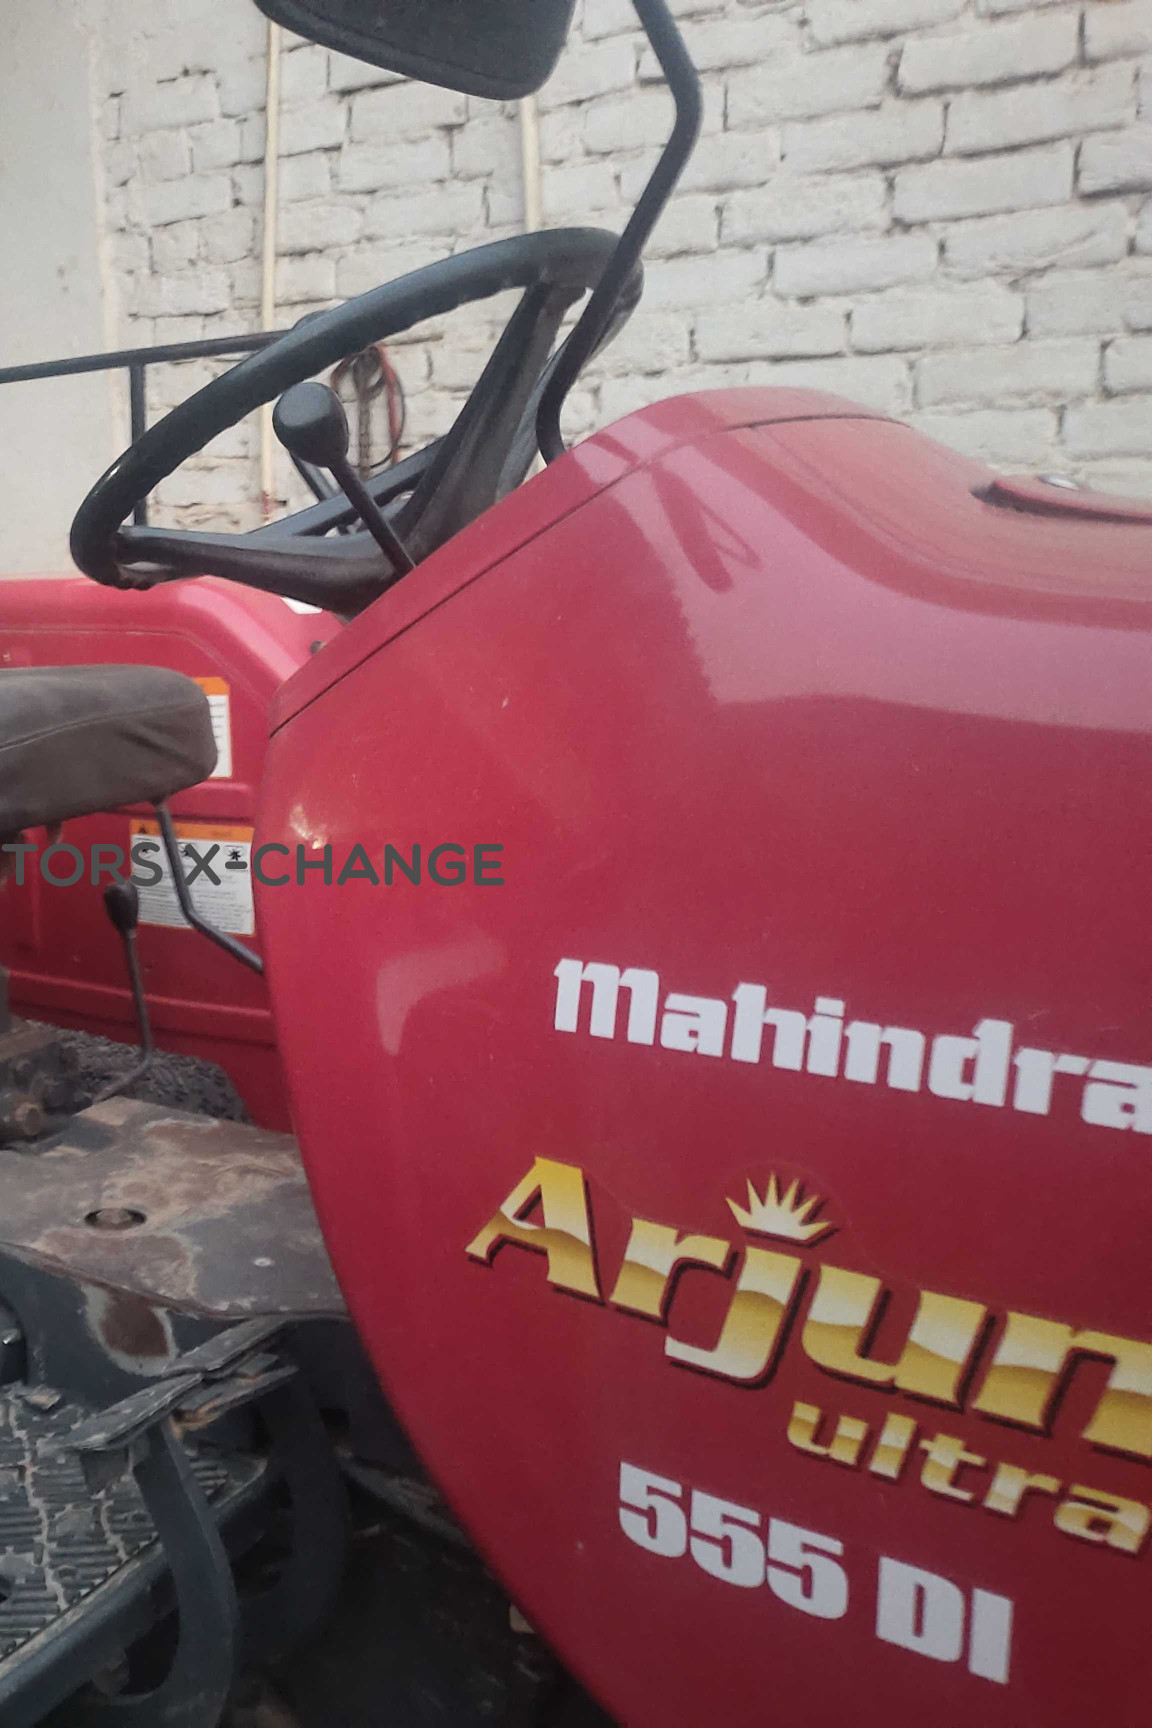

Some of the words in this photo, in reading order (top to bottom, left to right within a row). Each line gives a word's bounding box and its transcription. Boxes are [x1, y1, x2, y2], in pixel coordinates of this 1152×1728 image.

[465, 1155, 1152, 1463] Arjun
[618, 1461, 849, 1621] 555
[875, 1554, 1014, 1686] DI
[787, 1401, 1151, 1556] ultra
